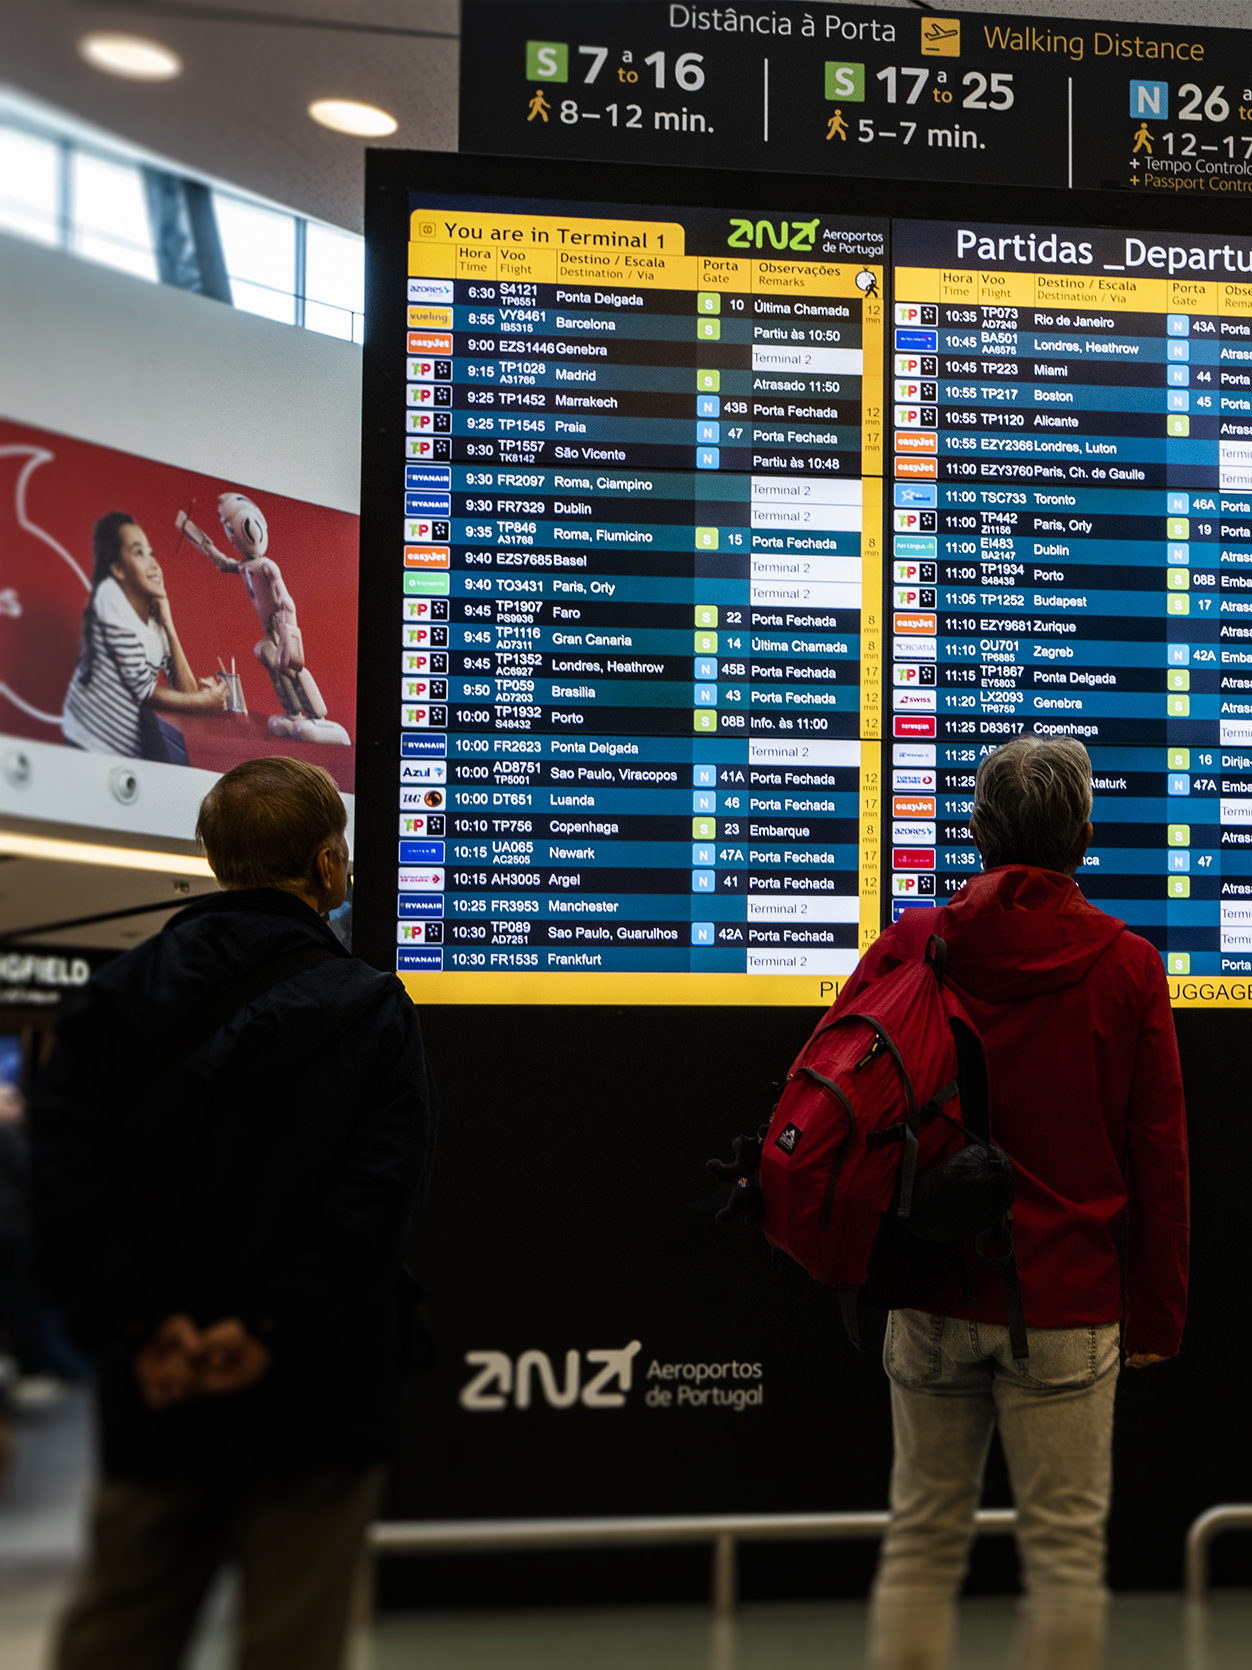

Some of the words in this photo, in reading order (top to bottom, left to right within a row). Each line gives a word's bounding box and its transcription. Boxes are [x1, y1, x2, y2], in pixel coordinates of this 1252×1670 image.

[670, 4, 791, 35] Distância
[801, 12, 815, 37] à
[826, 15, 895, 41] Porta
[984, 26, 1083, 60] Walking
[1095, 33, 1204, 61] Distance
[537, 48, 557, 76] S
[579, 46, 608, 83] 7
[622, 51, 632, 62] a
[618, 68, 638, 83] to
[645, 51, 704, 91] 16
[835, 68, 854, 96] S
[937, 71, 946, 83] a
[877, 67, 929, 104] 17
[933, 88, 952, 103] to
[963, 72, 1014, 110] 25
[1138, 86, 1159, 113] N
[1178, 84, 1229, 122] 26
[1243, 89, 1252, 101] a
[653, 104, 714, 131] min.
[926, 120, 986, 148] min.
[1145, 156, 1191, 174] Tempo
[1145, 173, 1204, 191] Passport
[445, 223, 482, 239] You
[491, 229, 523, 241] are
[532, 228, 548, 242] in
[557, 229, 646, 248] Terminal
[657, 235, 663, 248] 1
[823, 229, 883, 243] Aeroportos
[958, 230, 1093, 264] Partidas
[460, 248, 490, 258] Hora
[501, 250, 525, 260] Voo
[561, 253, 610, 265] Destino
[625, 256, 665, 267] Escala
[704, 260, 738, 270] Porta
[823, 242, 836, 253] de
[840, 243, 883, 257] Portugal
[460, 261, 487, 271] Time
[501, 264, 531, 275] Flight
[561, 267, 623, 278] Destination
[637, 271, 654, 280] Via
[703, 273, 729, 283] Gate
[759, 276, 804, 286] Remarks
[469, 287, 495, 299] 6:30
[500, 283, 536, 295] S4121
[557, 291, 591, 303] Ponta
[595, 293, 643, 307] Delgada
[730, 299, 744, 310] 10
[794, 303, 849, 316] Chamada
[946, 311, 977, 322] 10:35
[981, 307, 1018, 319] TP073
[1035, 314, 1053, 325] Rio
[1056, 315, 1069, 326] de
[1073, 316, 1114, 328] Janeiro
[1193, 321, 1216, 332] 43A
[1221, 323, 1250, 335] Porta
[411, 339, 449, 348] easyJet
[468, 365, 494, 377] 9:15
[499, 361, 546, 374] TP1028
[556, 369, 596, 381] Madrid
[753, 379, 805, 391] Atrasado
[809, 381, 839, 392] 11:50
[946, 412, 976, 424] 10:55
[981, 413, 1024, 425] TP1120
[1034, 415, 1078, 427] Alicante
[466, 500, 492, 511] 9:30
[498, 501, 545, 513] FR7329
[554, 502, 591, 514] Dublin
[753, 510, 798, 521] Terminal
[803, 512, 810, 521] 2
[457, 711, 489, 722] 10:00
[494, 706, 541, 717] TP1932
[552, 712, 583, 723] Porto
[722, 716, 745, 727] 08B
[751, 717, 775, 728] Info.
[779, 717, 793, 729] às
[797, 718, 828, 729] 11:00
[946, 722, 975, 732] 11:25
[980, 722, 1024, 734] D83617
[1034, 722, 1098, 736] Copenhaga
[403, 767, 430, 777] Azul
[455, 820, 487, 831] 10:10
[492, 820, 532, 832] TP756
[550, 820, 618, 835] Copenhaga
[725, 823, 739, 834] 23
[750, 825, 809, 839] Embarque
[452, 954, 485, 965] 10:30
[491, 954, 538, 965] FR1535
[548, 954, 601, 965] Frankfurt
[647, 1360, 762, 1384] Aeroportos
[646, 1386, 672, 1406] de
[678, 1384, 762, 1411] Portugal
